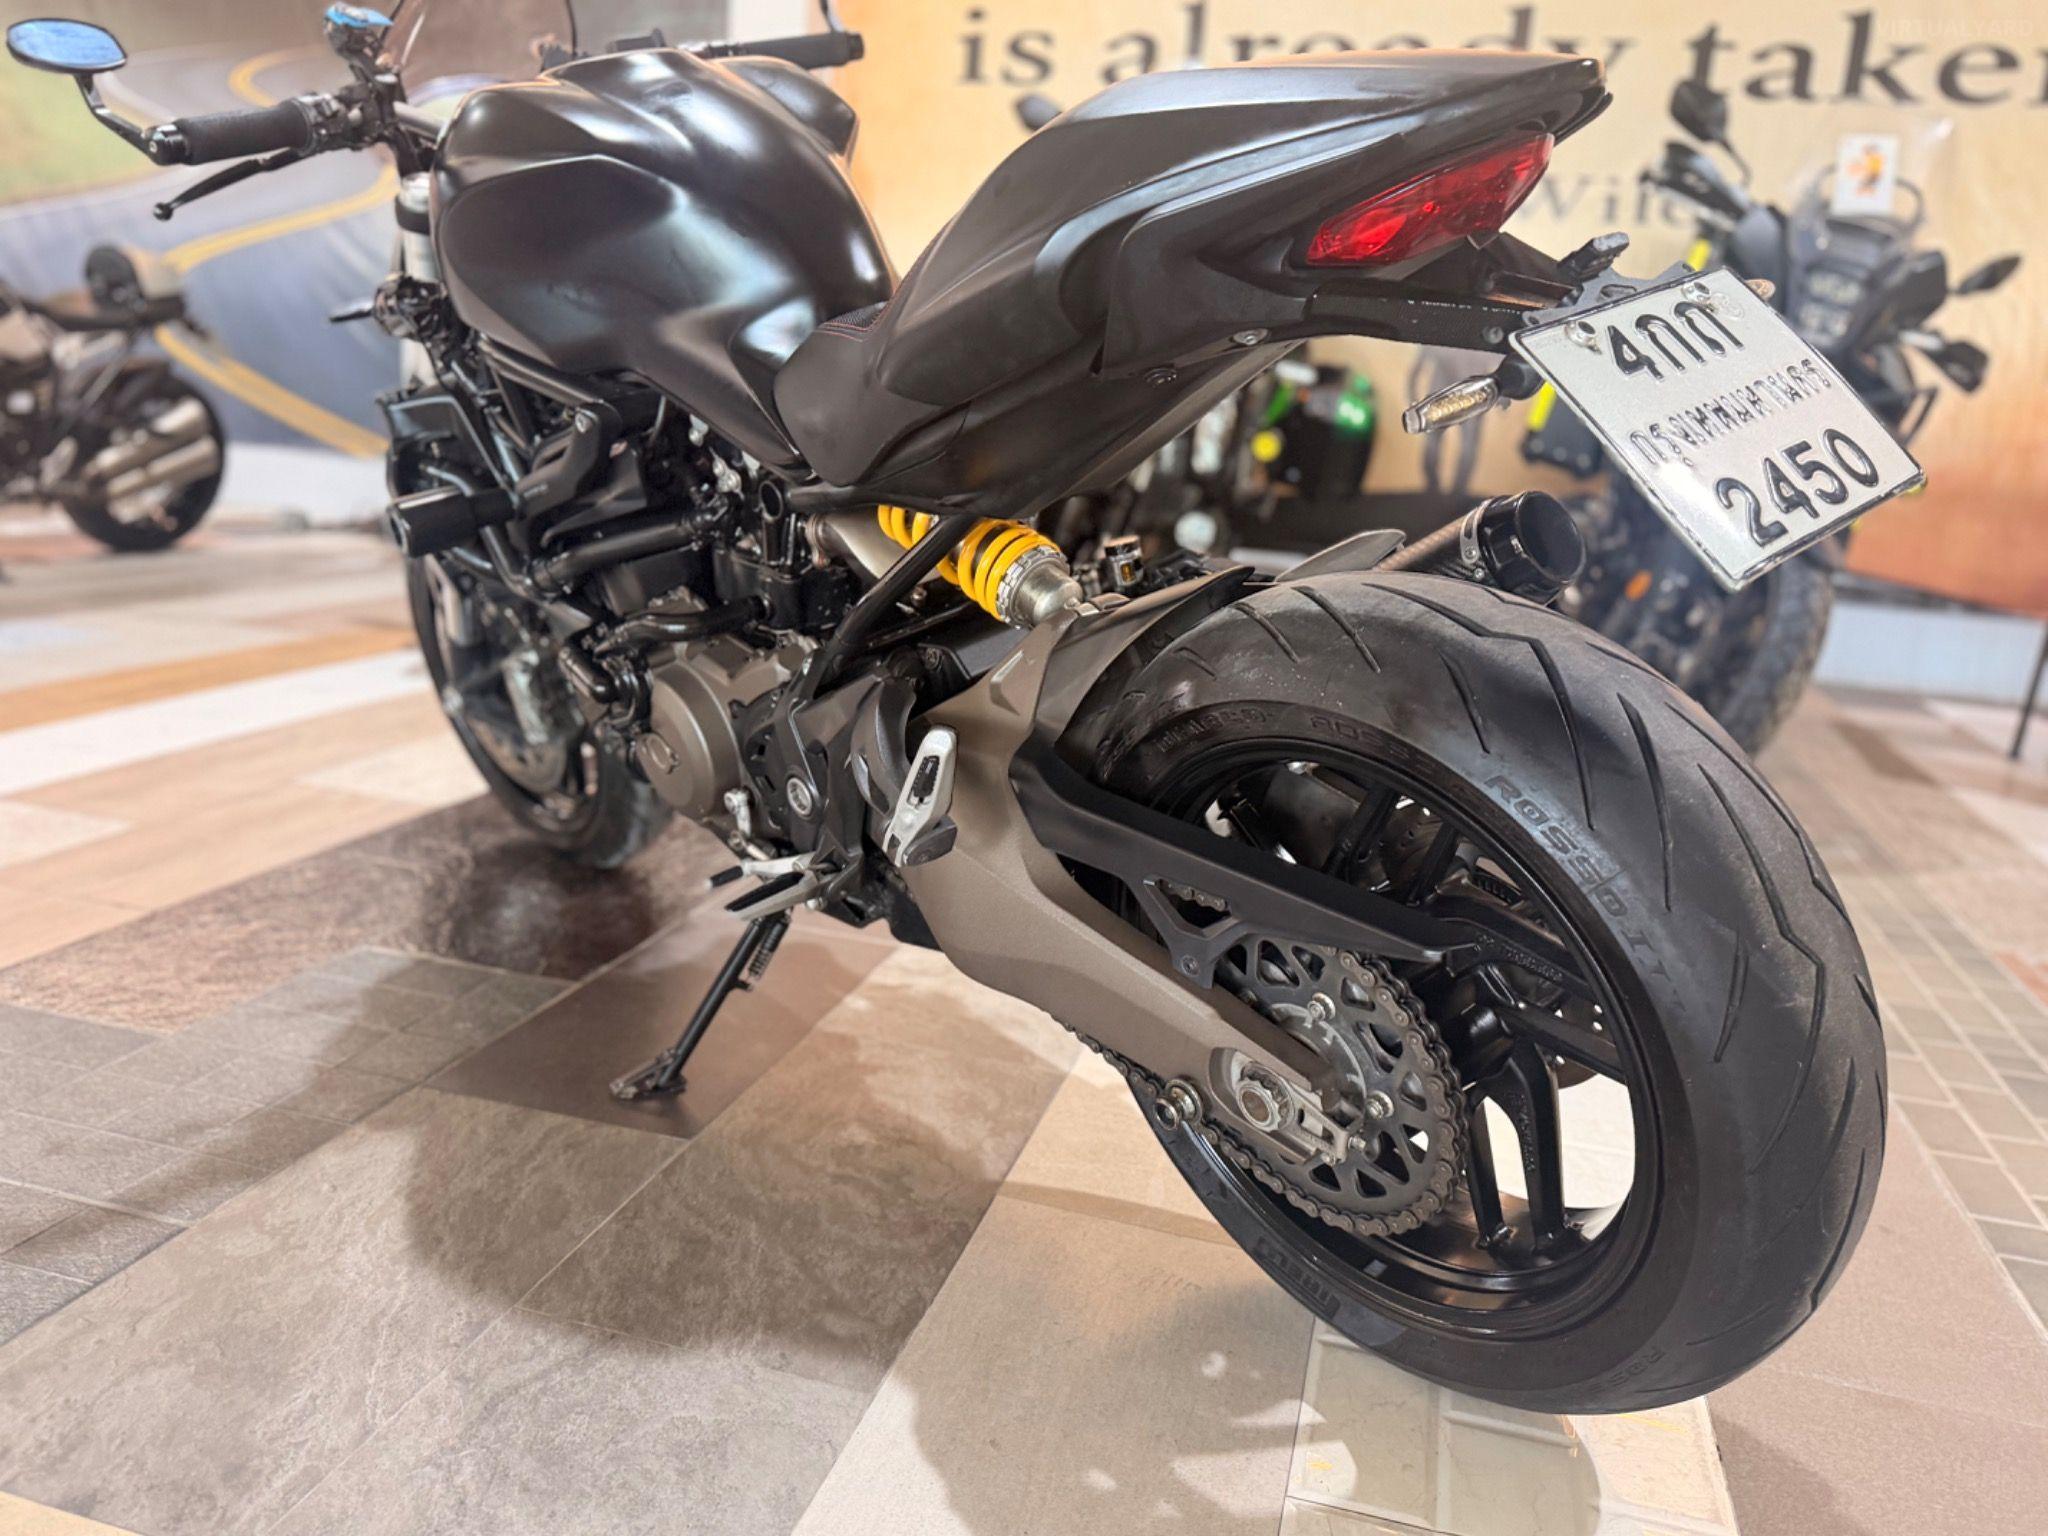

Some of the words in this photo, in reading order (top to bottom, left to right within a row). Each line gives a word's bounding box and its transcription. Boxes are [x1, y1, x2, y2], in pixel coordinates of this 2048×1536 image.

[961, 8, 1056, 86] is
[1629, 359, 1832, 467] กรุงเทพมหานคร
[1715, 428, 1879, 548] 2450
[1484, 774, 1629, 918] ROSSO
